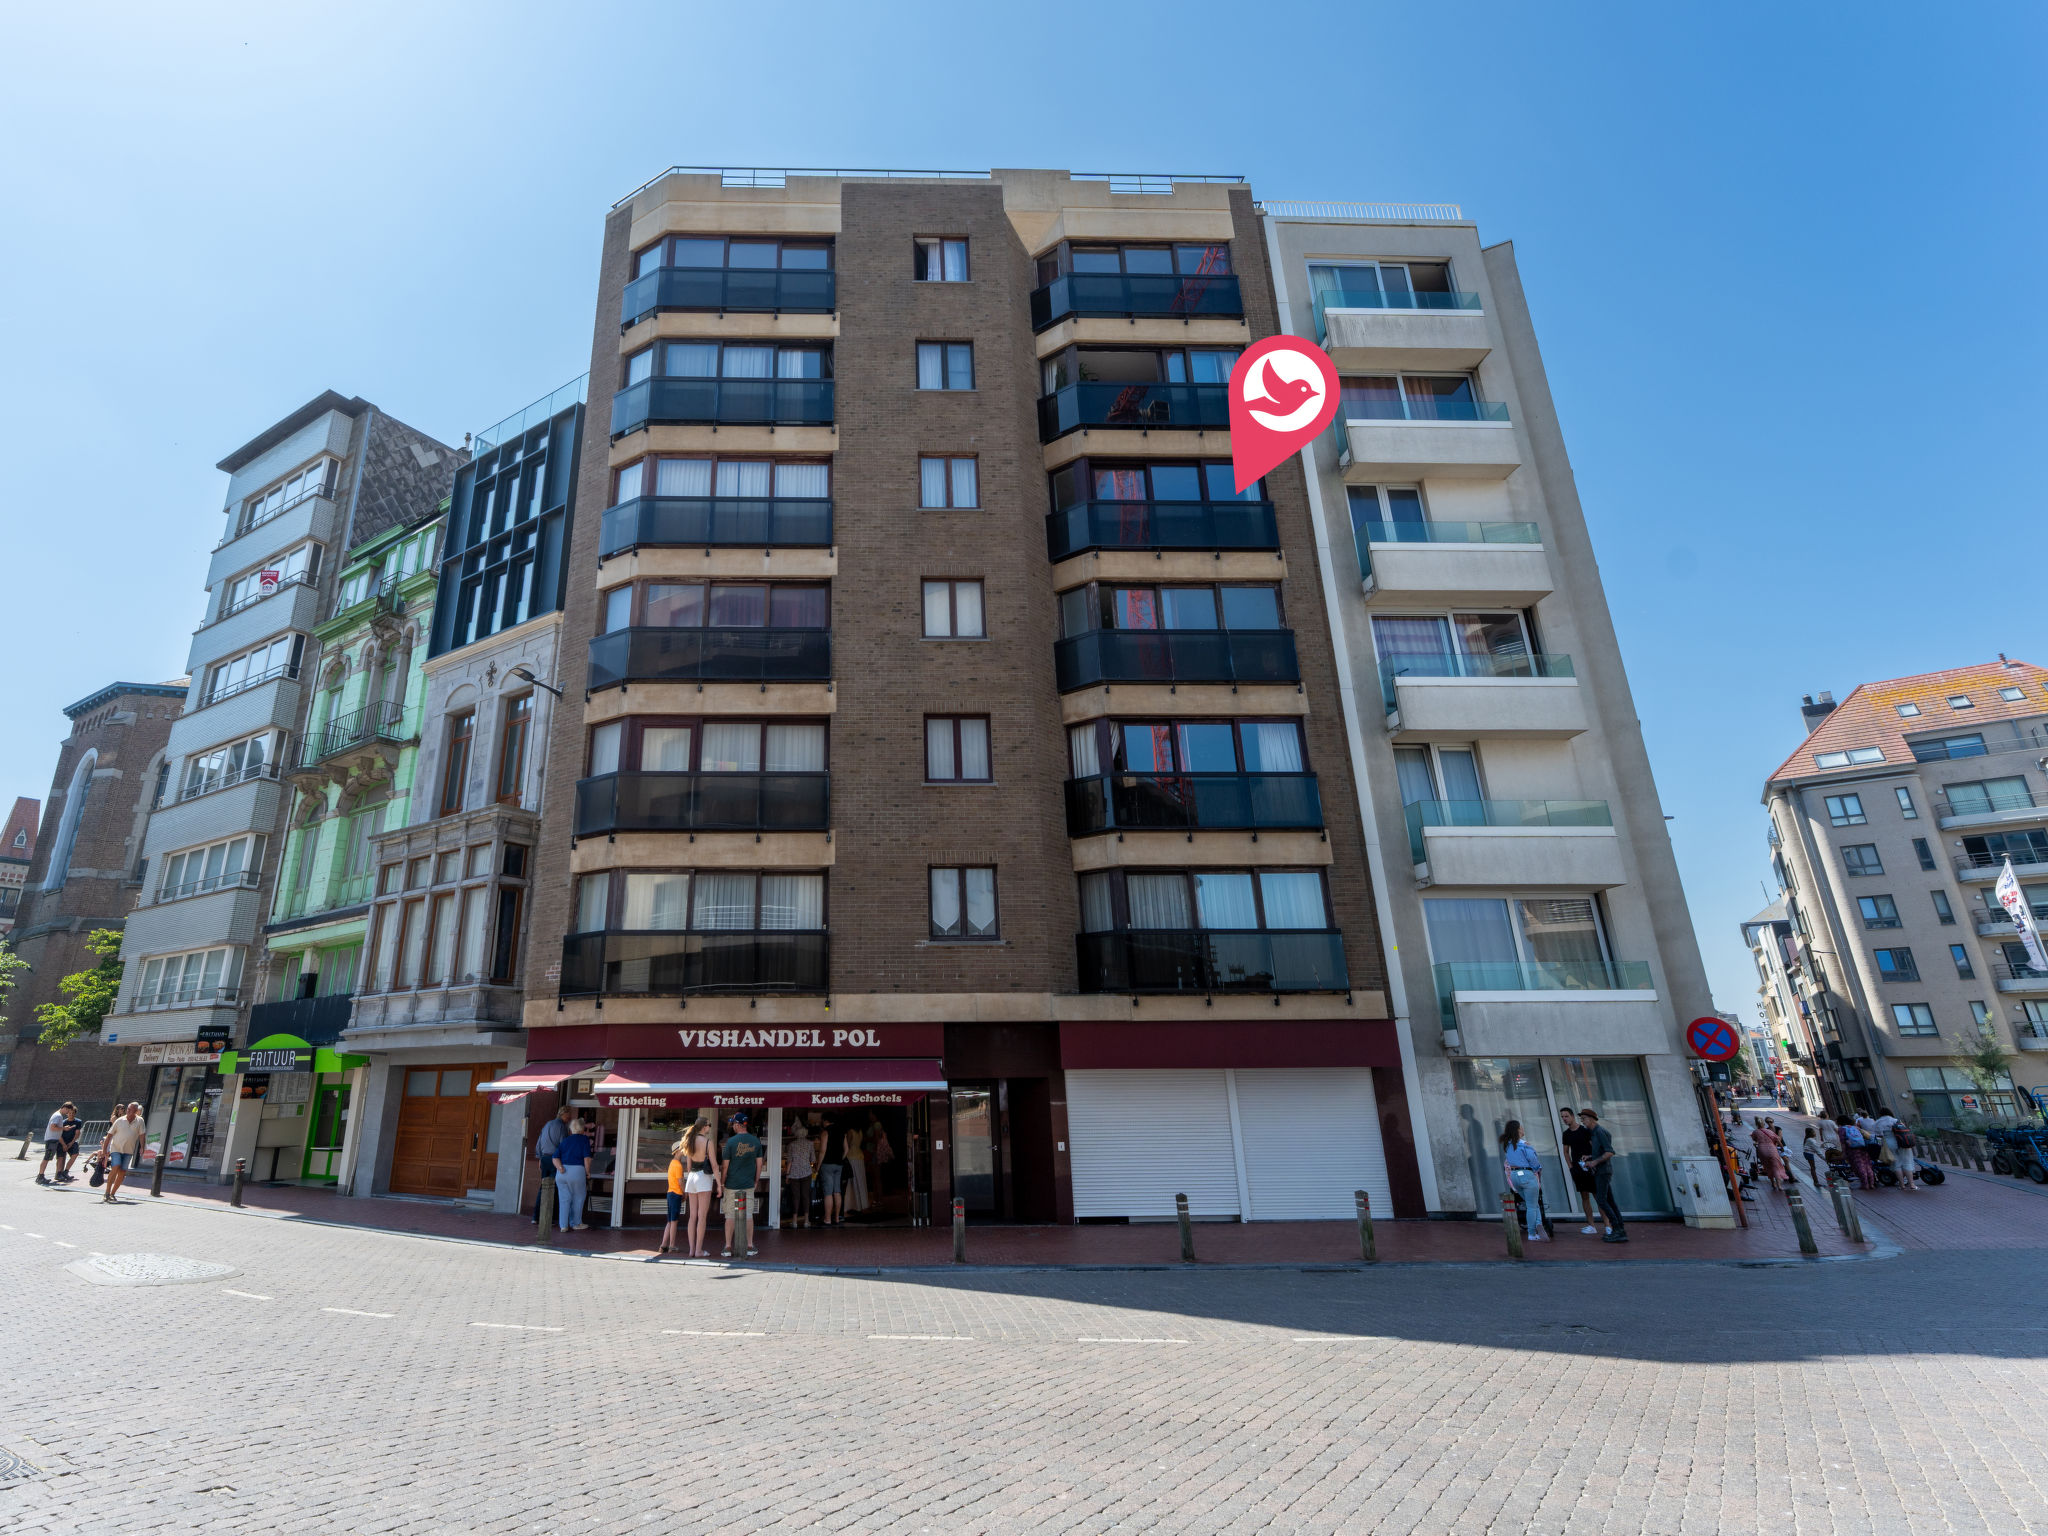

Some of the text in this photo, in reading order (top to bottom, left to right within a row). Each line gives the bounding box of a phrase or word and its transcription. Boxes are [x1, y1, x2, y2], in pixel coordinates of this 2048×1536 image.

[1756, 1002, 1773, 1047] HOTEL
[678, 1029, 881, 1048] VISHANDEL POL
[143, 1046, 152, 1054] Take
[143, 1054, 159, 1063] Delivery
[249, 1050, 296, 1067] FRITUUR
[608, 1096, 667, 1107] Kibbeling
[713, 1095, 765, 1105] Traiteur
[811, 1093, 902, 1104] Koude Schotels
